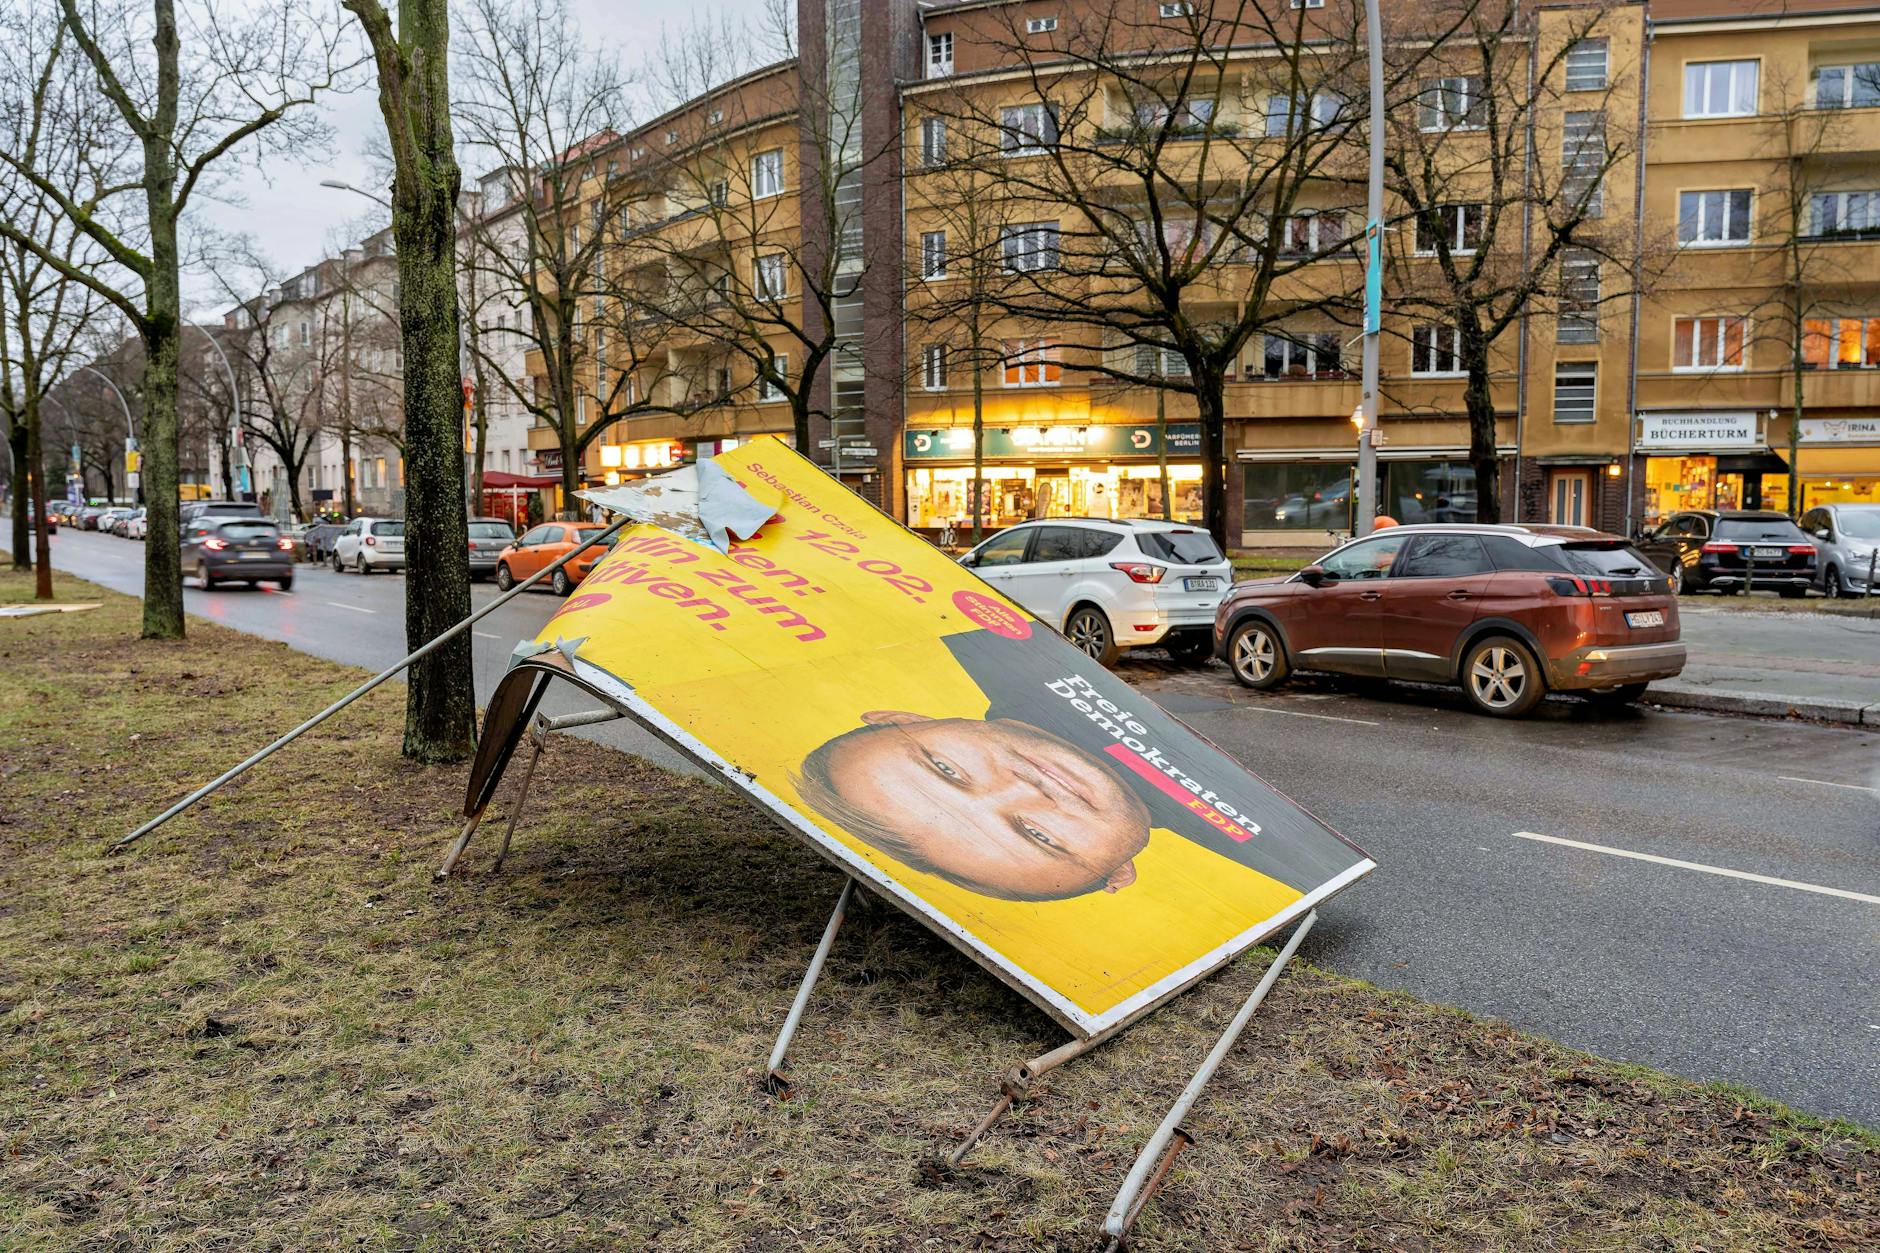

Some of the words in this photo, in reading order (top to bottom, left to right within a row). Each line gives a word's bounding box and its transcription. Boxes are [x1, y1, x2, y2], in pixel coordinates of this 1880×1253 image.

[1165, 432, 1201, 440] ARFÜMER
[1650, 428, 1748, 440] BÜCHERTURM
[1662, 417, 1737, 426] BUCHHANDLUNG
[1847, 423, 1877, 433] IRINA
[747, 463, 822, 514] Sebastian
[821, 512, 867, 540] Czaja
[794, 529, 933, 604] 12.02.
[694, 568, 827, 642] zum
[964, 595, 1023, 636] Stimmen
[970, 608, 1002, 627] FDP
[988, 605, 1015, 622] Alle
[1062, 674, 1147, 737] Freie
[1045, 679, 1263, 836] Demokraten
[1186, 798, 1245, 838] FDP
